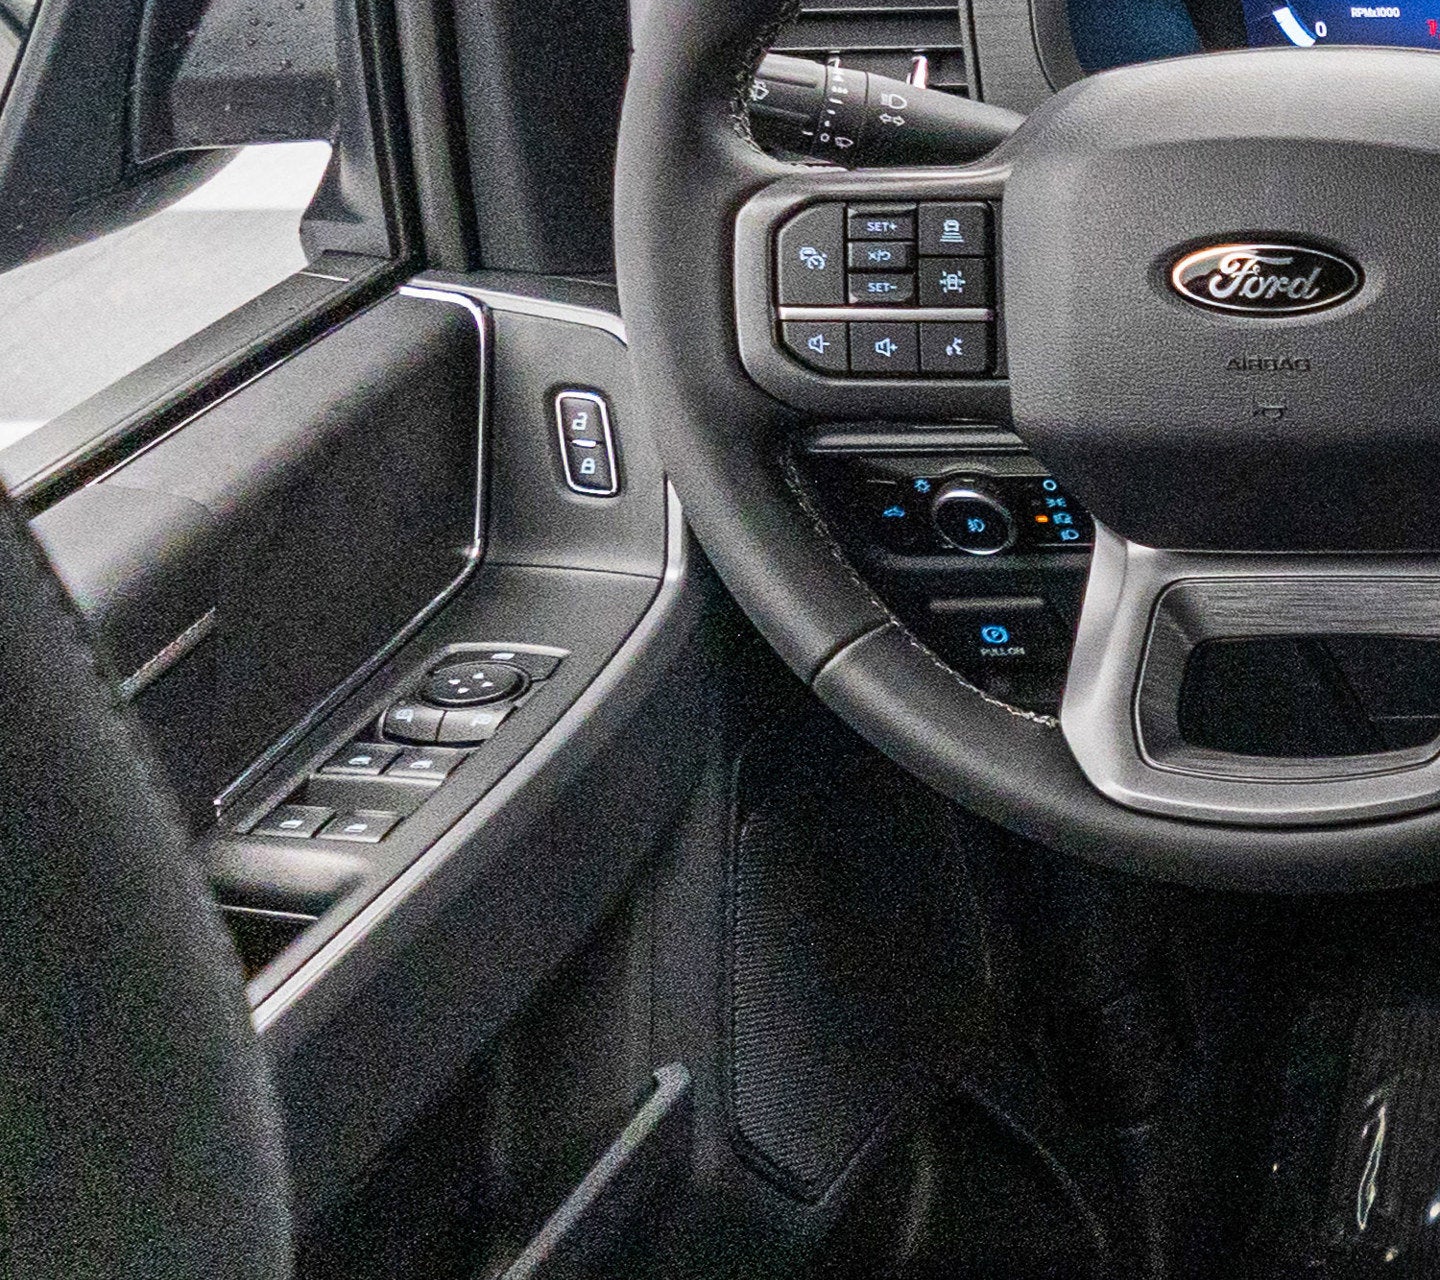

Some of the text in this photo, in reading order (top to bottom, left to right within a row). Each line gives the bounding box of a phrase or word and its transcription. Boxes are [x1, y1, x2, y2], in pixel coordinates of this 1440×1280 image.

[1350, 7, 1401, 18] RPMx1000
[1314, 21, 1327, 37] 0
[866, 221, 898, 232] SET+
[1208, 252, 1322, 299] Ford
